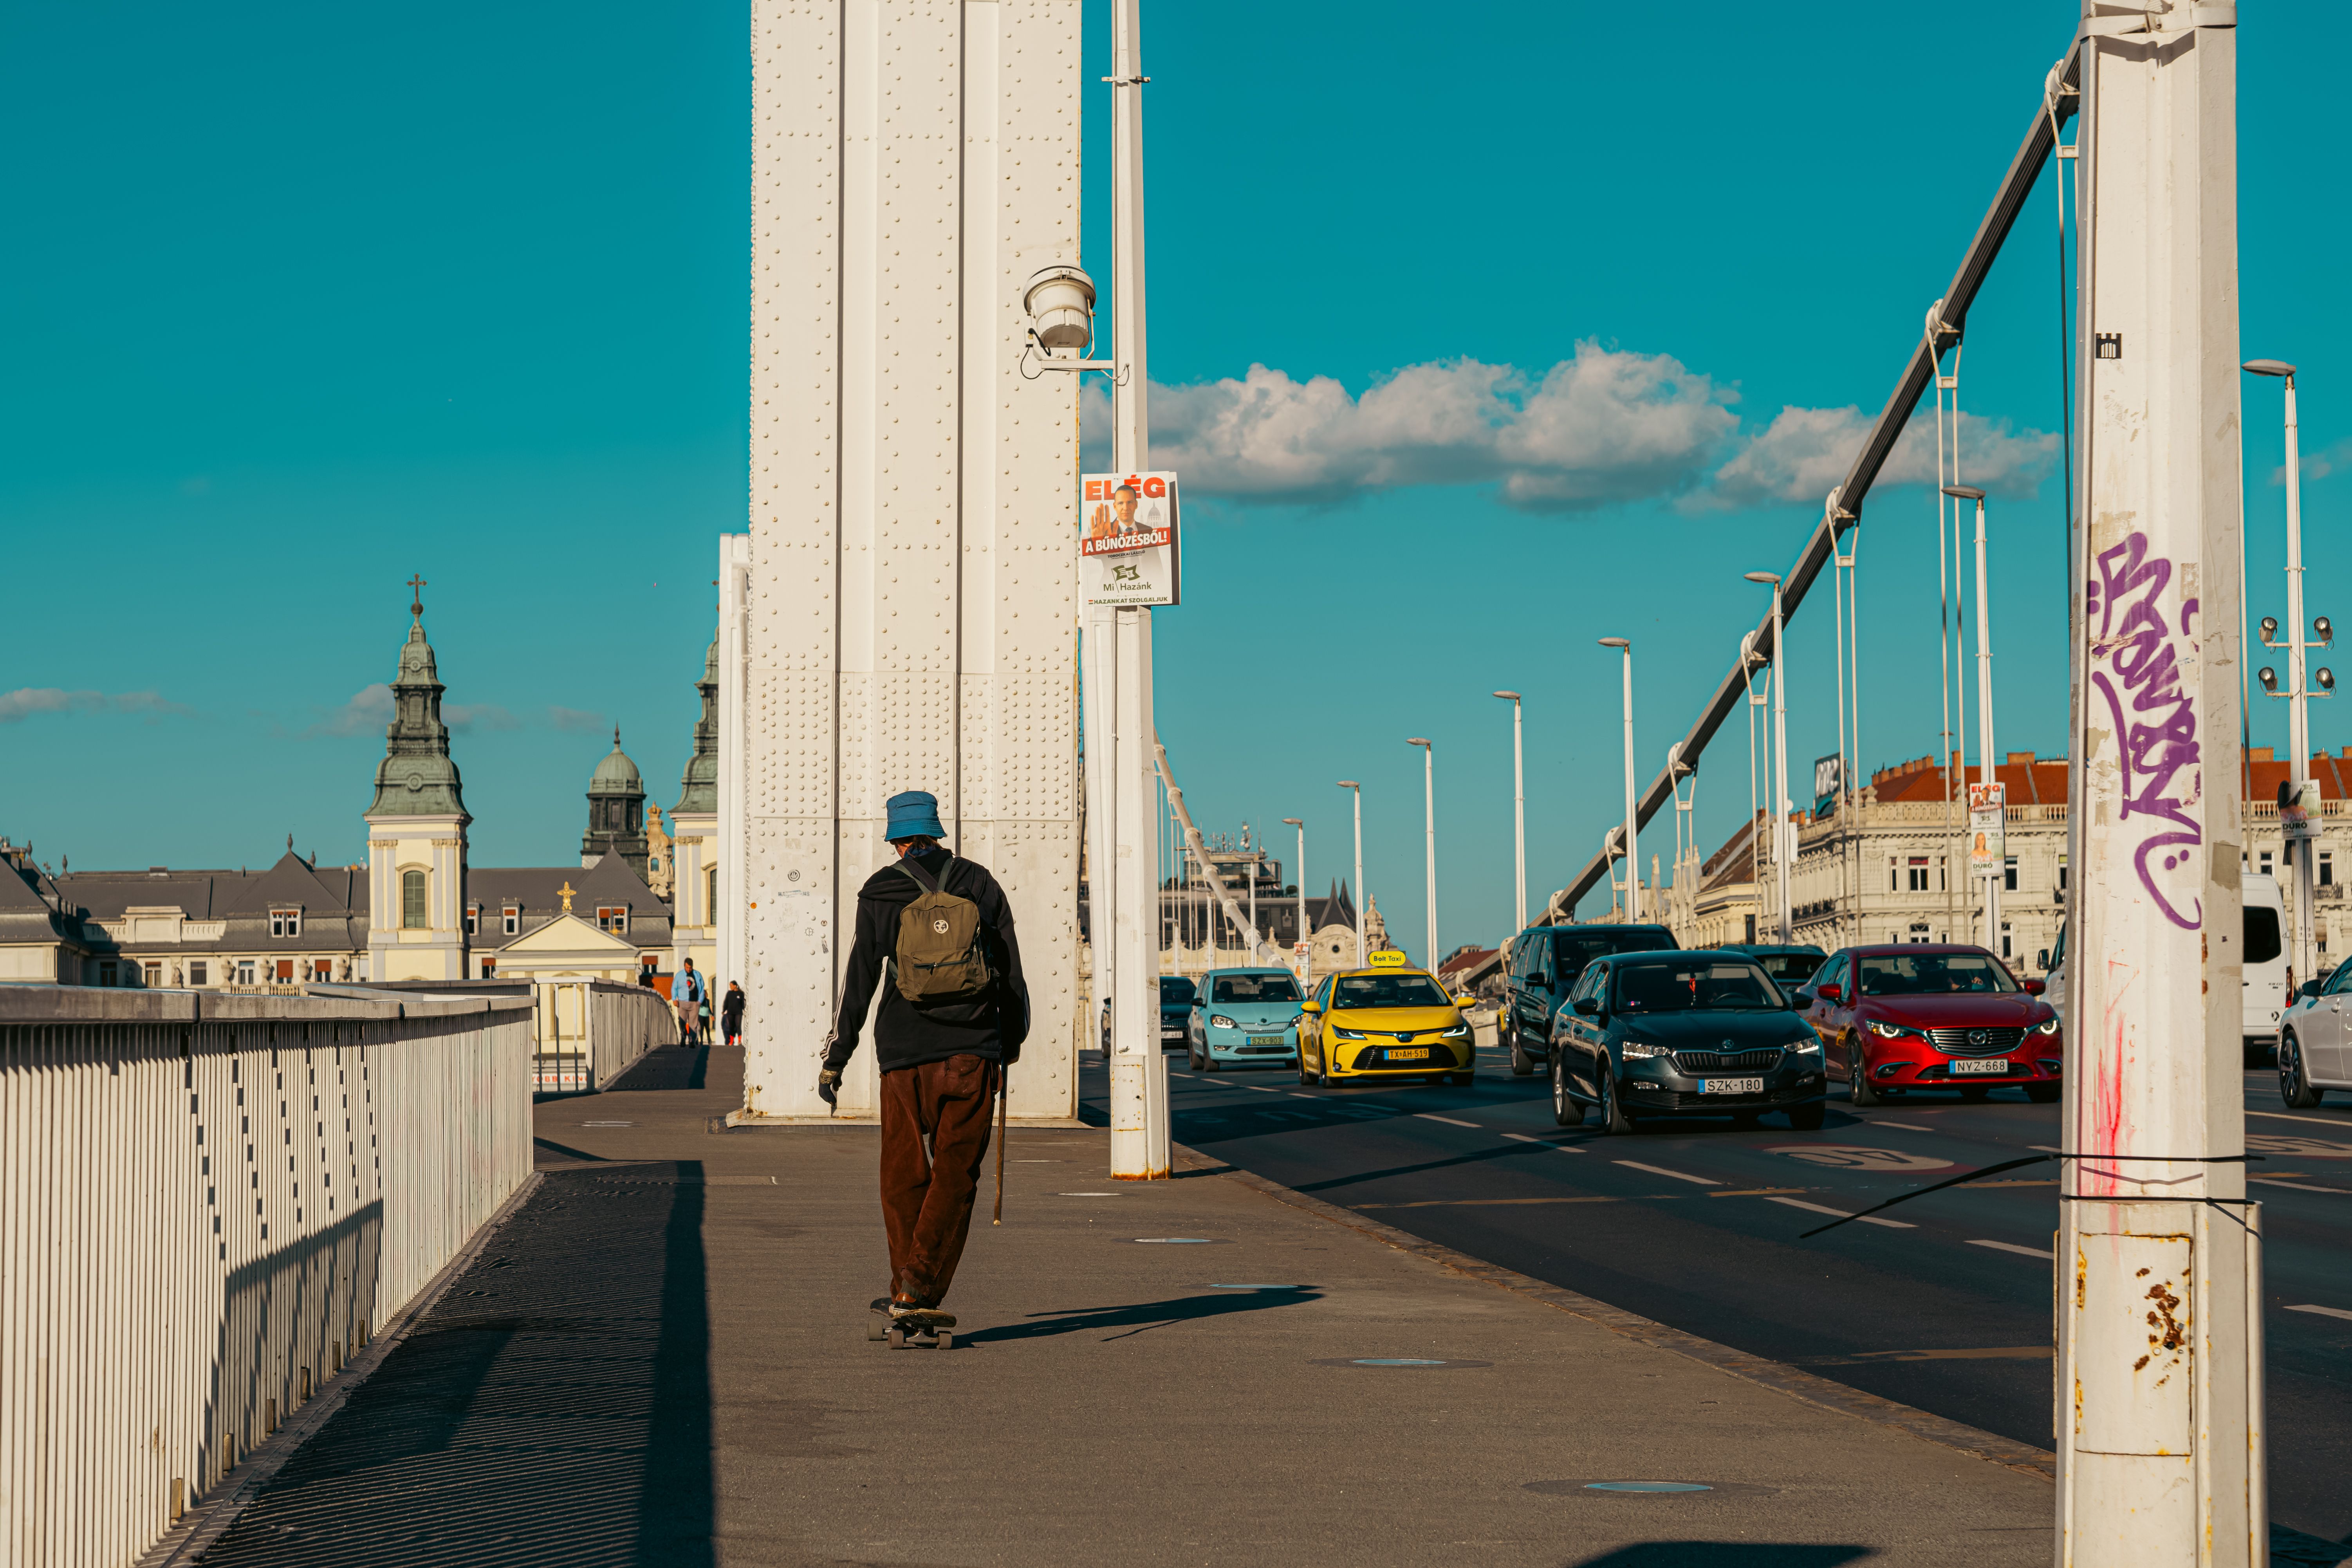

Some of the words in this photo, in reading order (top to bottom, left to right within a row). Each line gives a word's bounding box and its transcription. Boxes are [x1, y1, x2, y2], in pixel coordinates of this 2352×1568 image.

[1085, 474, 1166, 501] ELÉG
[1085, 541, 1094, 553] A
[1096, 529, 1167, 552] BŰNÖZÉSBŐL!
[1103, 583, 1114, 592] Mi
[1120, 581, 1152, 591] Hazánk
[1958, 1061, 2005, 1071] NYZ-668
[1708, 1079, 1760, 1092] SZK-180
